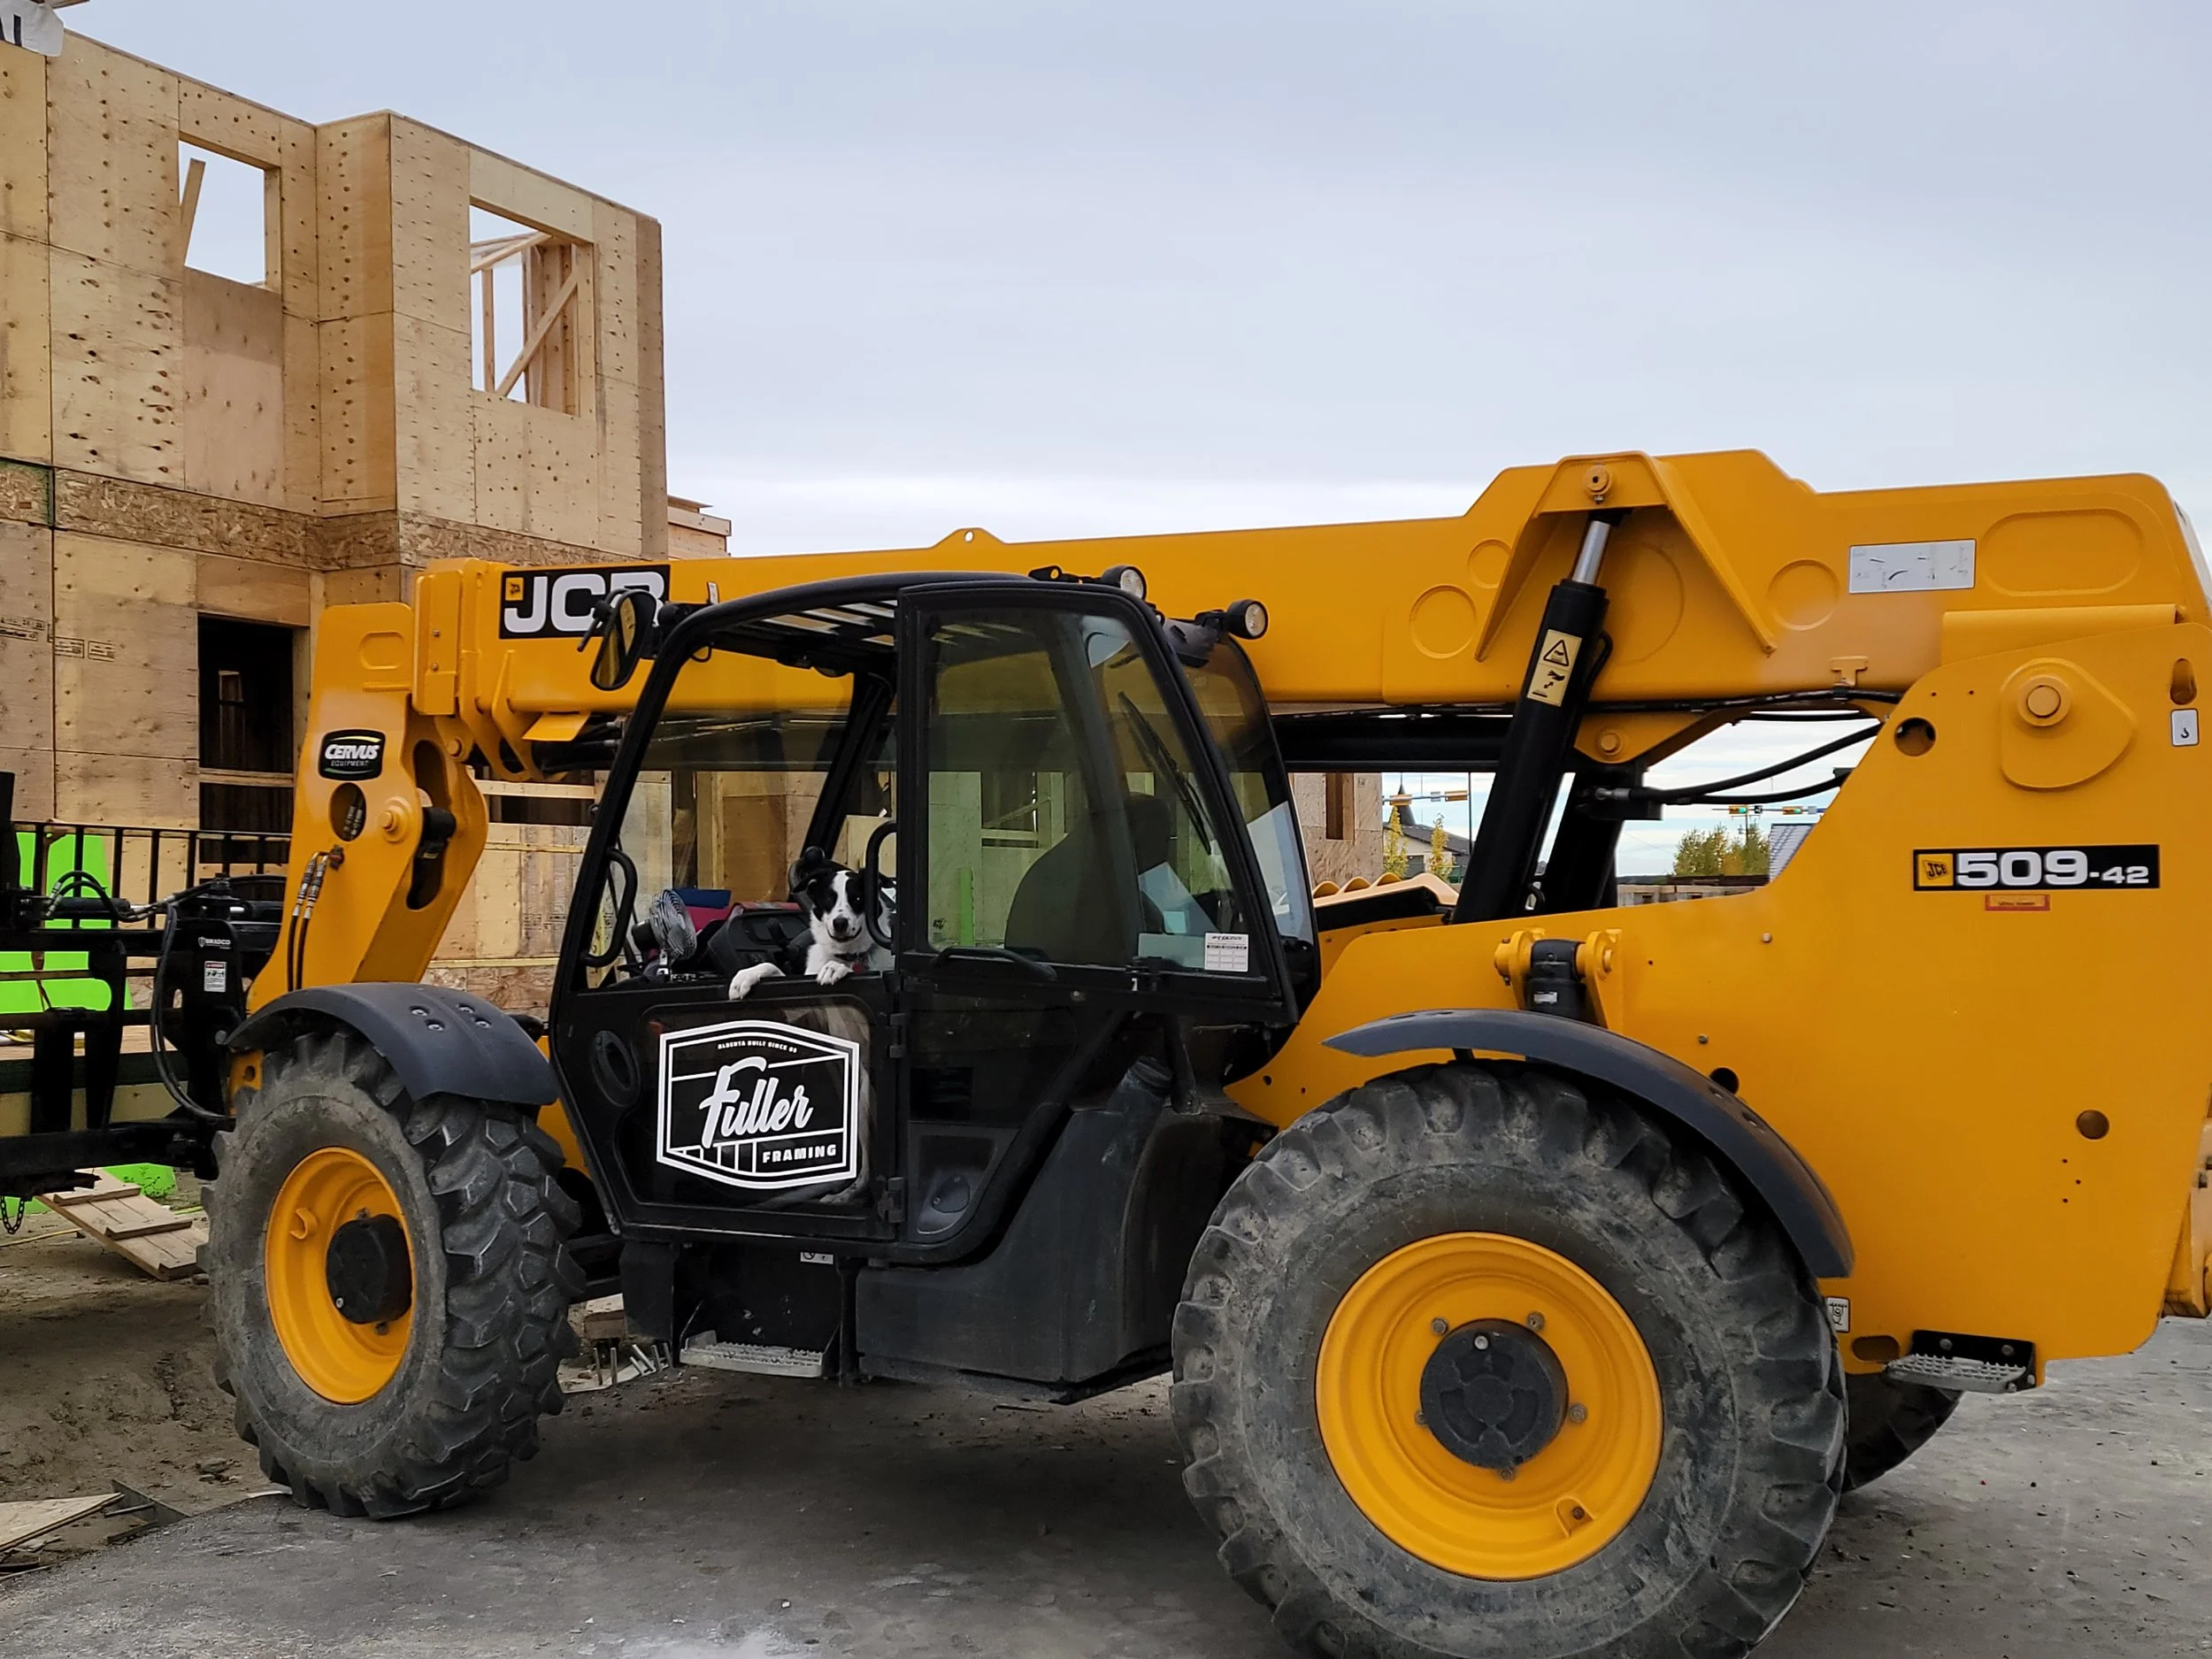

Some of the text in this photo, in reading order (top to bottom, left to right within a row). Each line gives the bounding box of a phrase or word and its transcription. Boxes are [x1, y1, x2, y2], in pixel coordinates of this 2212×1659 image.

[325, 744, 380, 759] CERVUS
[1956, 850, 2149, 887] 509-42
[699, 1056, 814, 1148] Fuller
[763, 1144, 836, 1164] FRAMING
